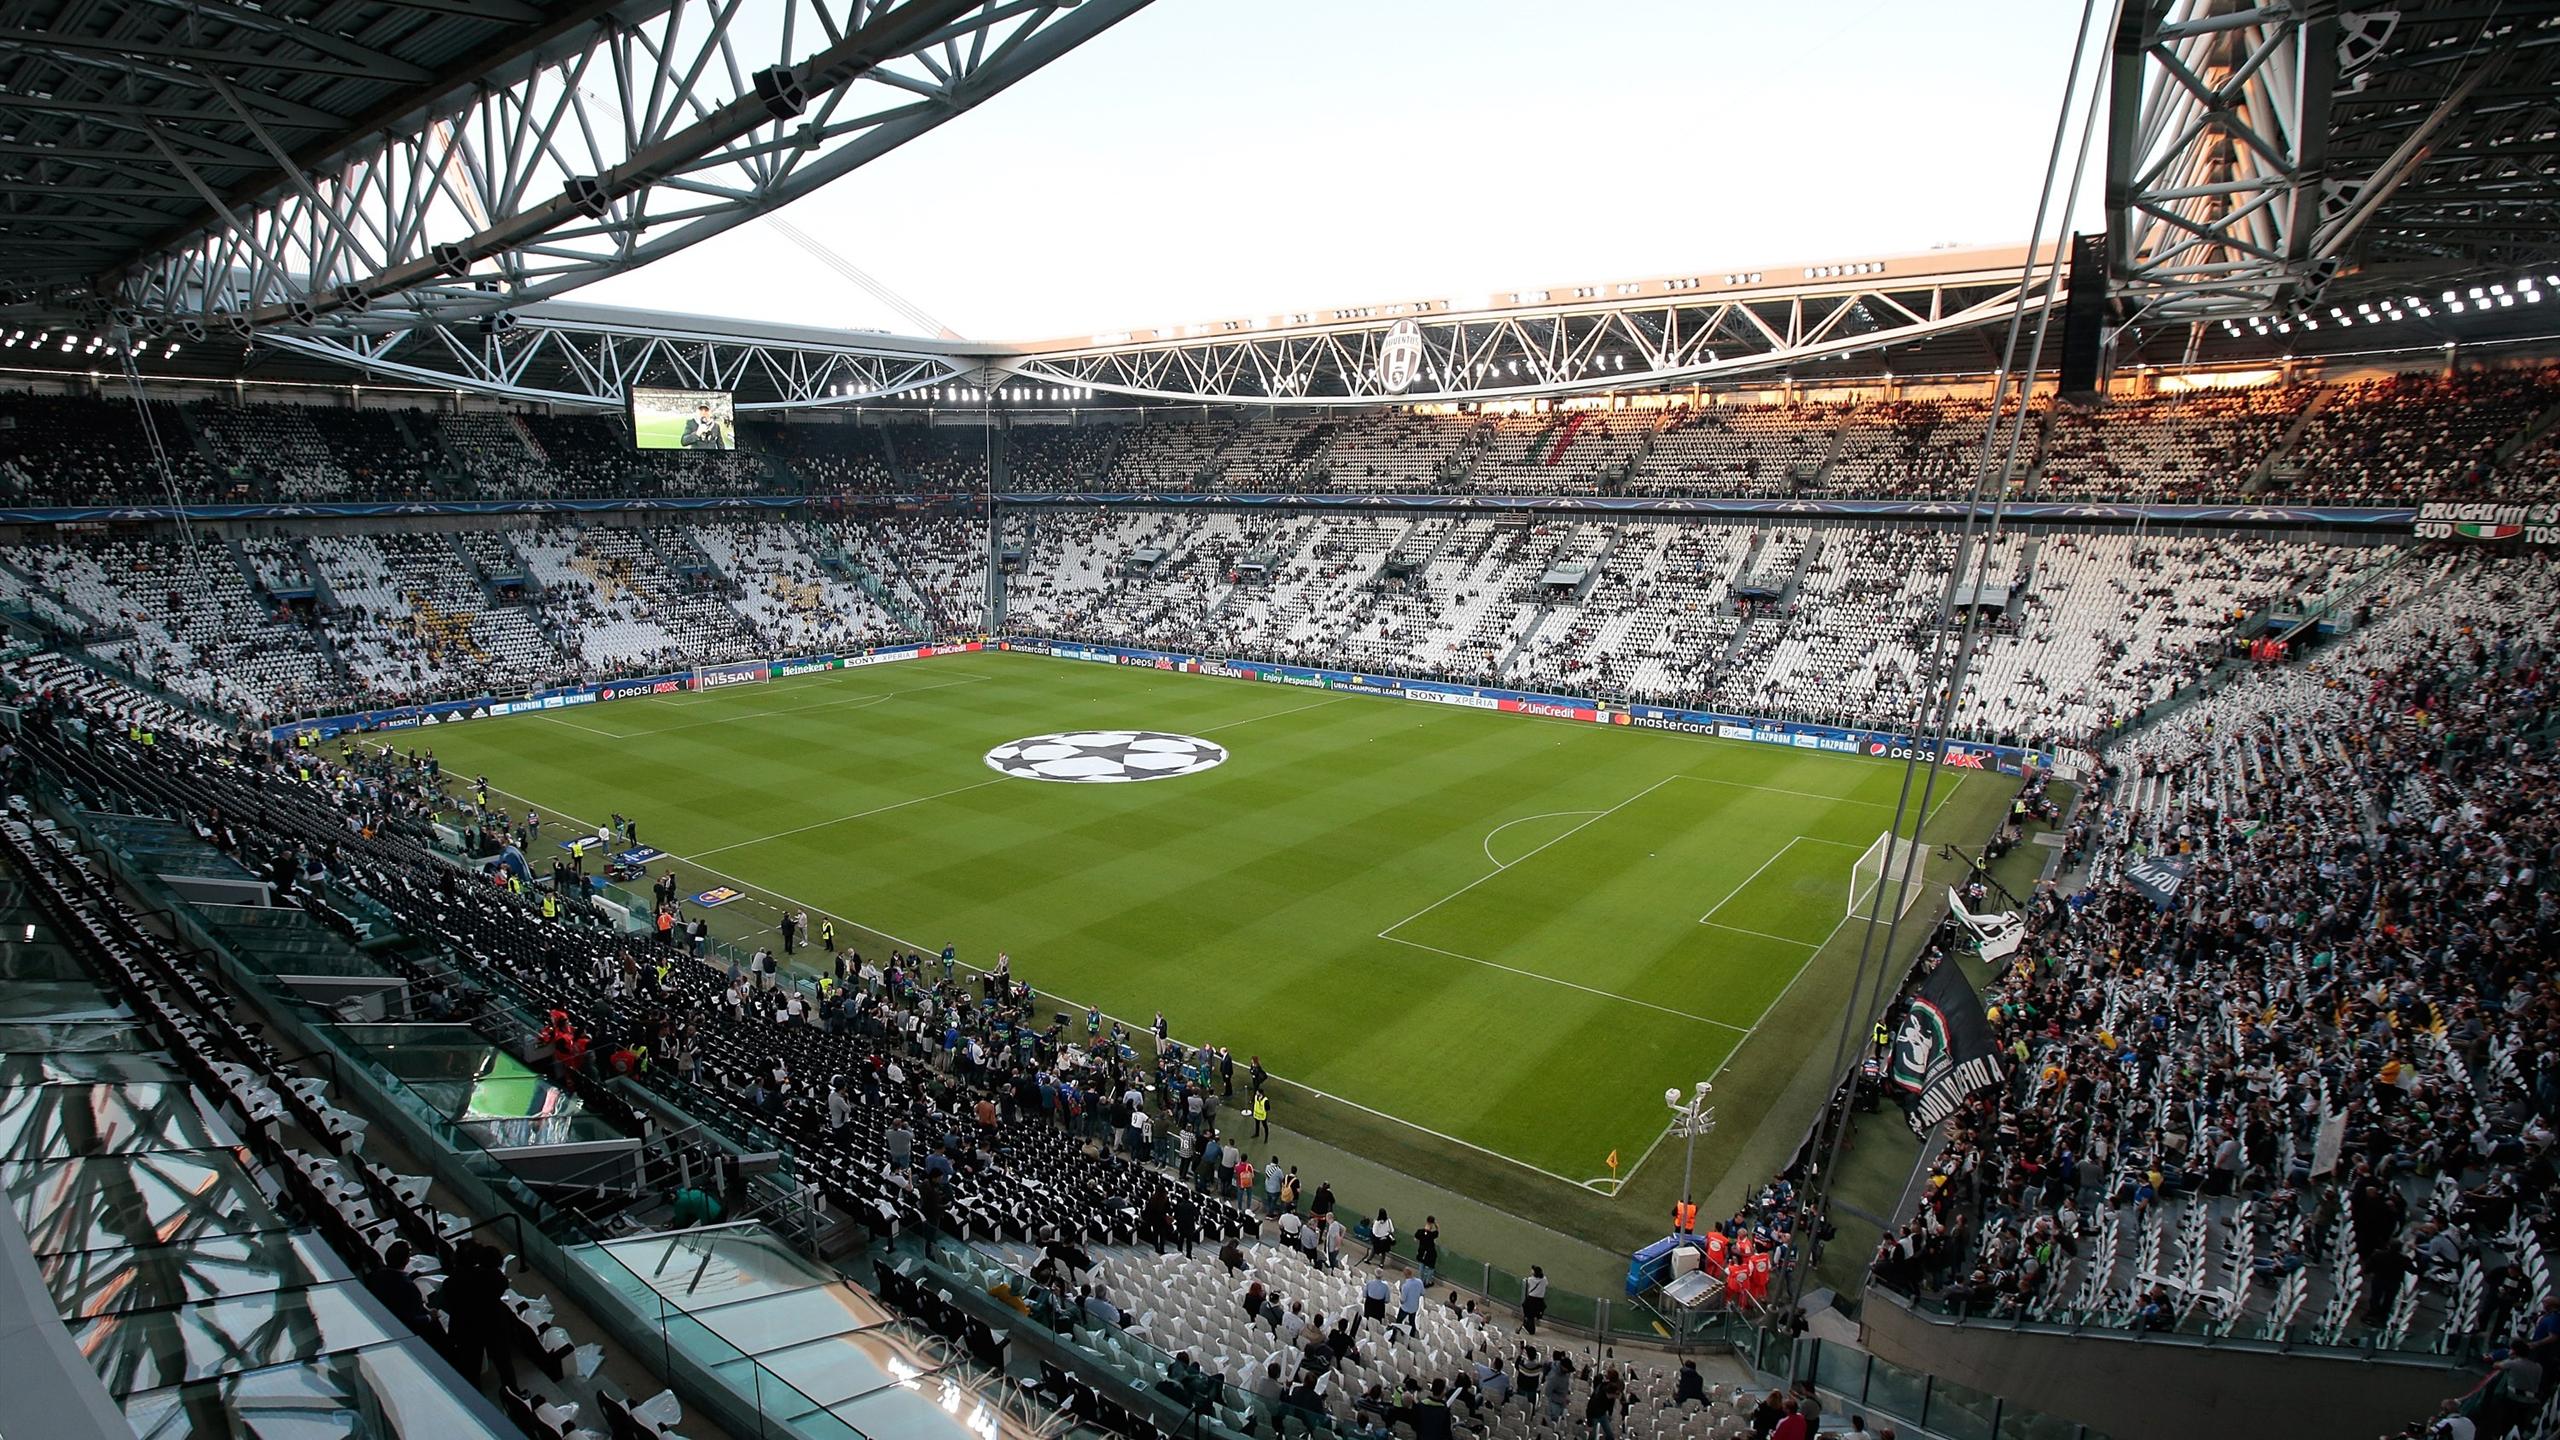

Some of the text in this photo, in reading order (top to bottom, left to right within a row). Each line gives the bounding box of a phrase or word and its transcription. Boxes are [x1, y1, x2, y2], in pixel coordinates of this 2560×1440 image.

[2419, 503, 2499, 521] DRUGHI
[2413, 523, 2452, 538] SUD
[937, 644, 967, 655] UniCredit
[1010, 644, 1049, 655] mastercard
[849, 652, 911, 666] SONY XPERIA
[1130, 658, 1154, 668] pepsi
[782, 663, 825, 677] Heineken
[1200, 665, 1242, 678] NISSAN
[704, 671, 755, 686] NISSAN
[1263, 673, 1325, 689] Enjoy Responsibly
[618, 680, 679, 699] pepsi MAX
[1334, 682, 1404, 697] UEFA CHAMPIONS LEAGUE
[565, 692, 595, 704] GAZPROM
[1410, 691, 1493, 708] SONY XPERIA
[512, 700, 542, 712] GAZPROM
[1528, 703, 1575, 718] UniCredit
[389, 717, 417, 728] RESPECT
[1634, 717, 1714, 735] mastercard
[1755, 731, 1791, 744] GAZPROM
[1820, 739, 1857, 752] GAZPROM
[1891, 747, 1935, 762] pes
[1942, 752, 1986, 769] MAX
